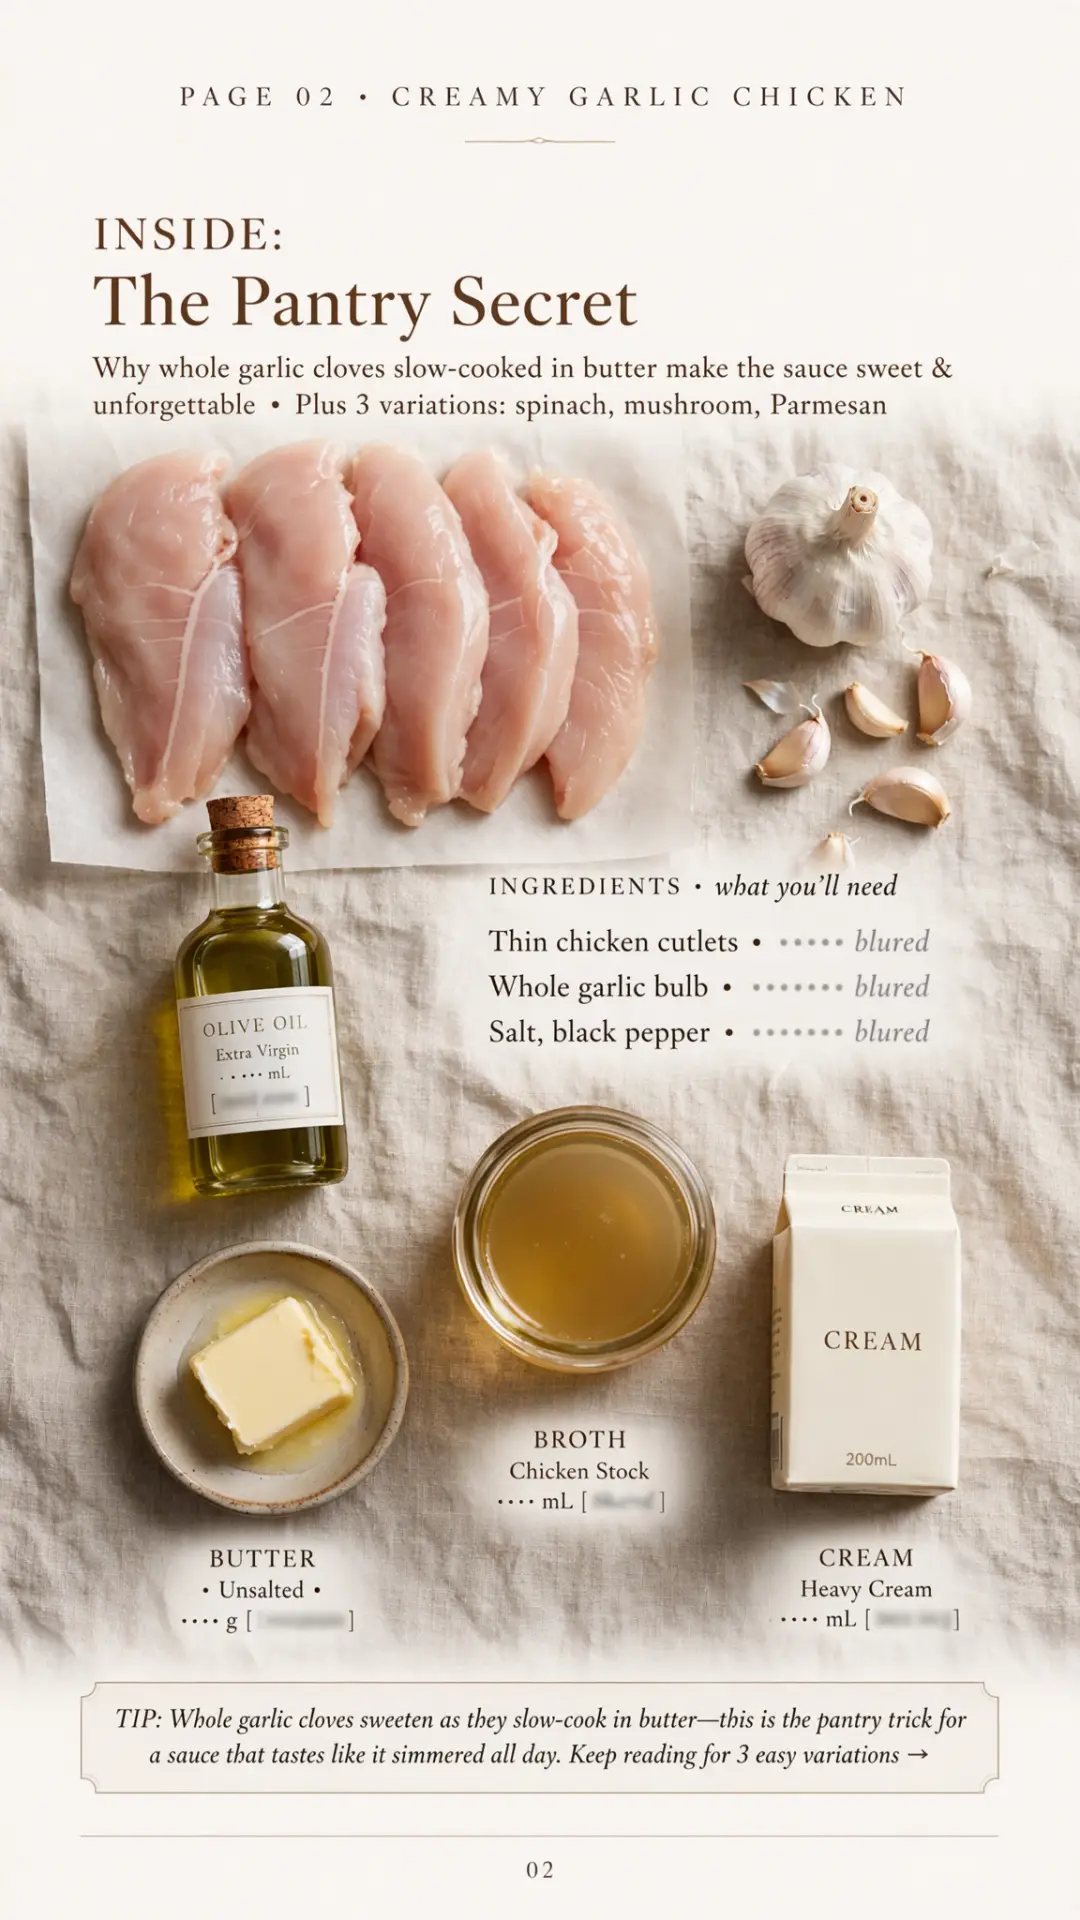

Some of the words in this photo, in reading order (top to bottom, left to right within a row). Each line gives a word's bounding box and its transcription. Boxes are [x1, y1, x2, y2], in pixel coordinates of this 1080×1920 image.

[202, 1017, 265, 1038] OLIVE
[273, 1014, 308, 1031] OIL
[216, 1048, 252, 1062] Extra
[257, 1043, 300, 1060] Virgin
[268, 1066, 291, 1080] mL
[840, 1204, 899, 1215] CREAM
[824, 1330, 922, 1352] CREAM
[845, 1452, 897, 1467] 200mL
